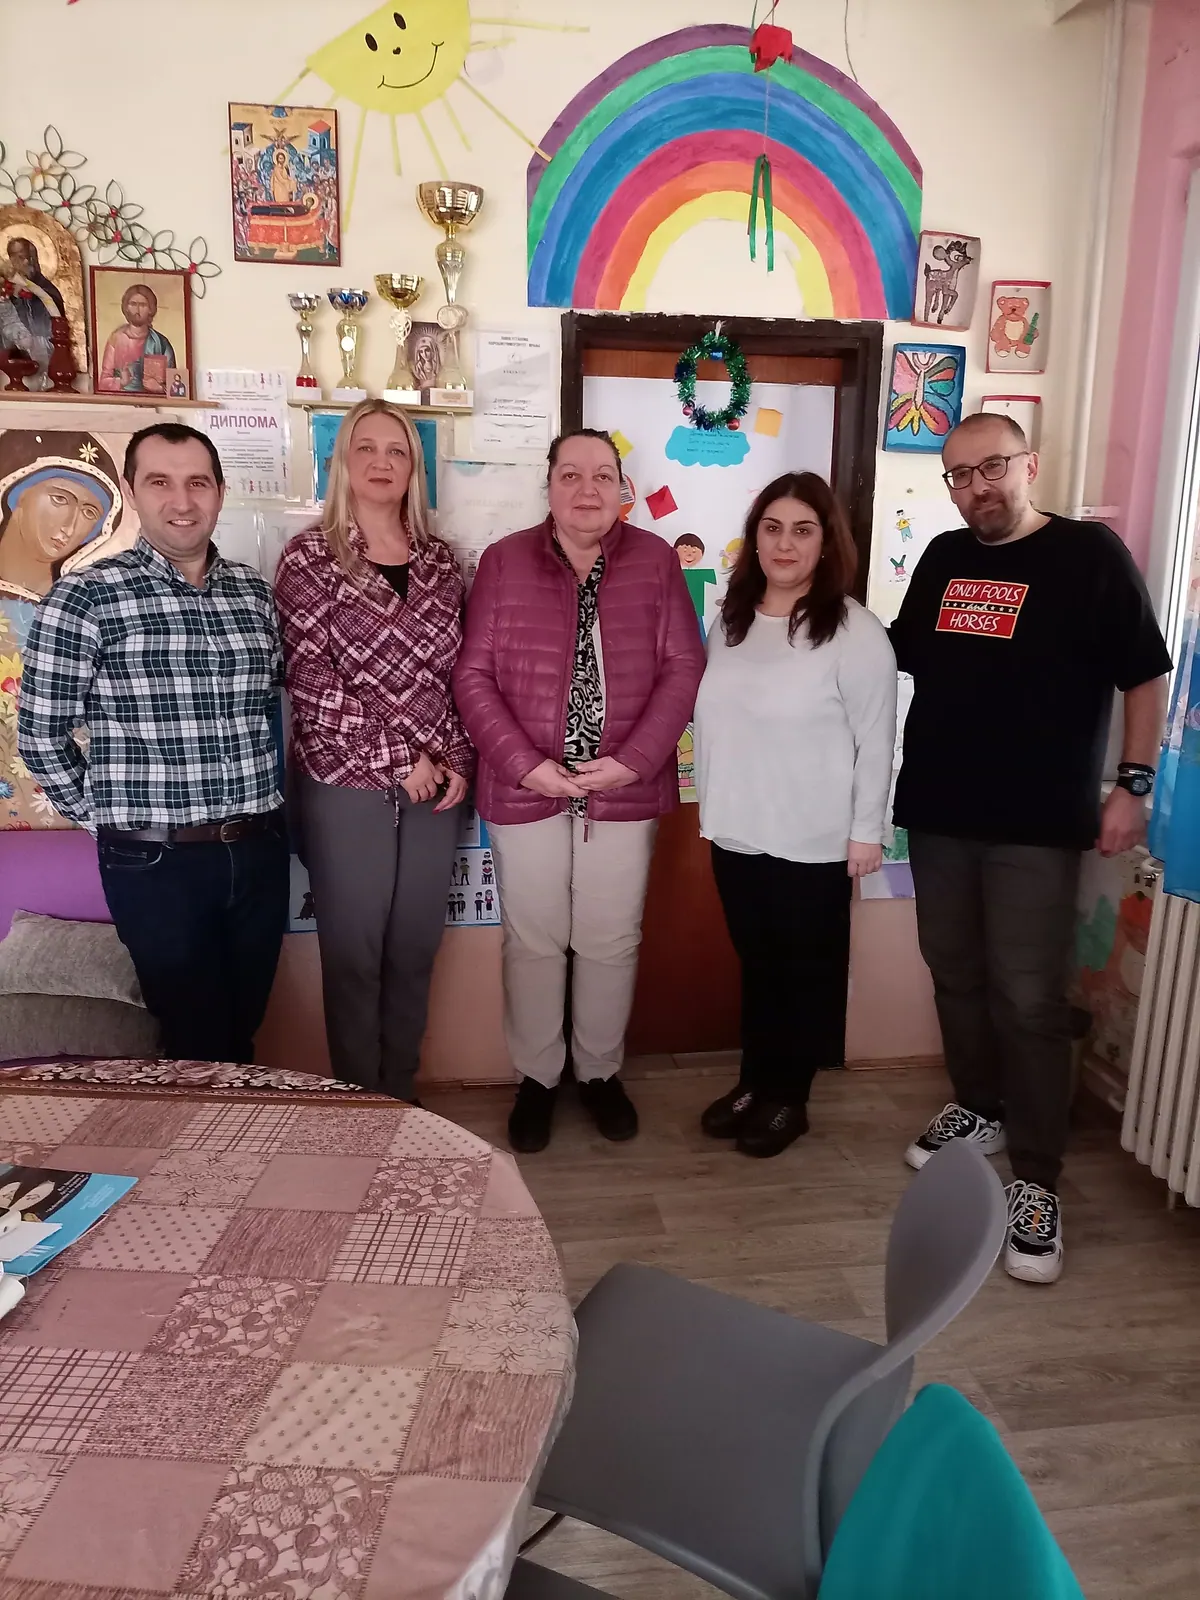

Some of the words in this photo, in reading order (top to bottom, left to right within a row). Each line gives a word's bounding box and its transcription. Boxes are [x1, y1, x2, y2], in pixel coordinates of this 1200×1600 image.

[210, 415, 278, 429] ДИПЛОМА
[949, 584, 981, 598] ONLY
[980, 585, 1022, 602] FOOLS
[966, 600, 990, 611] and
[950, 613, 1001, 632] HORSES
